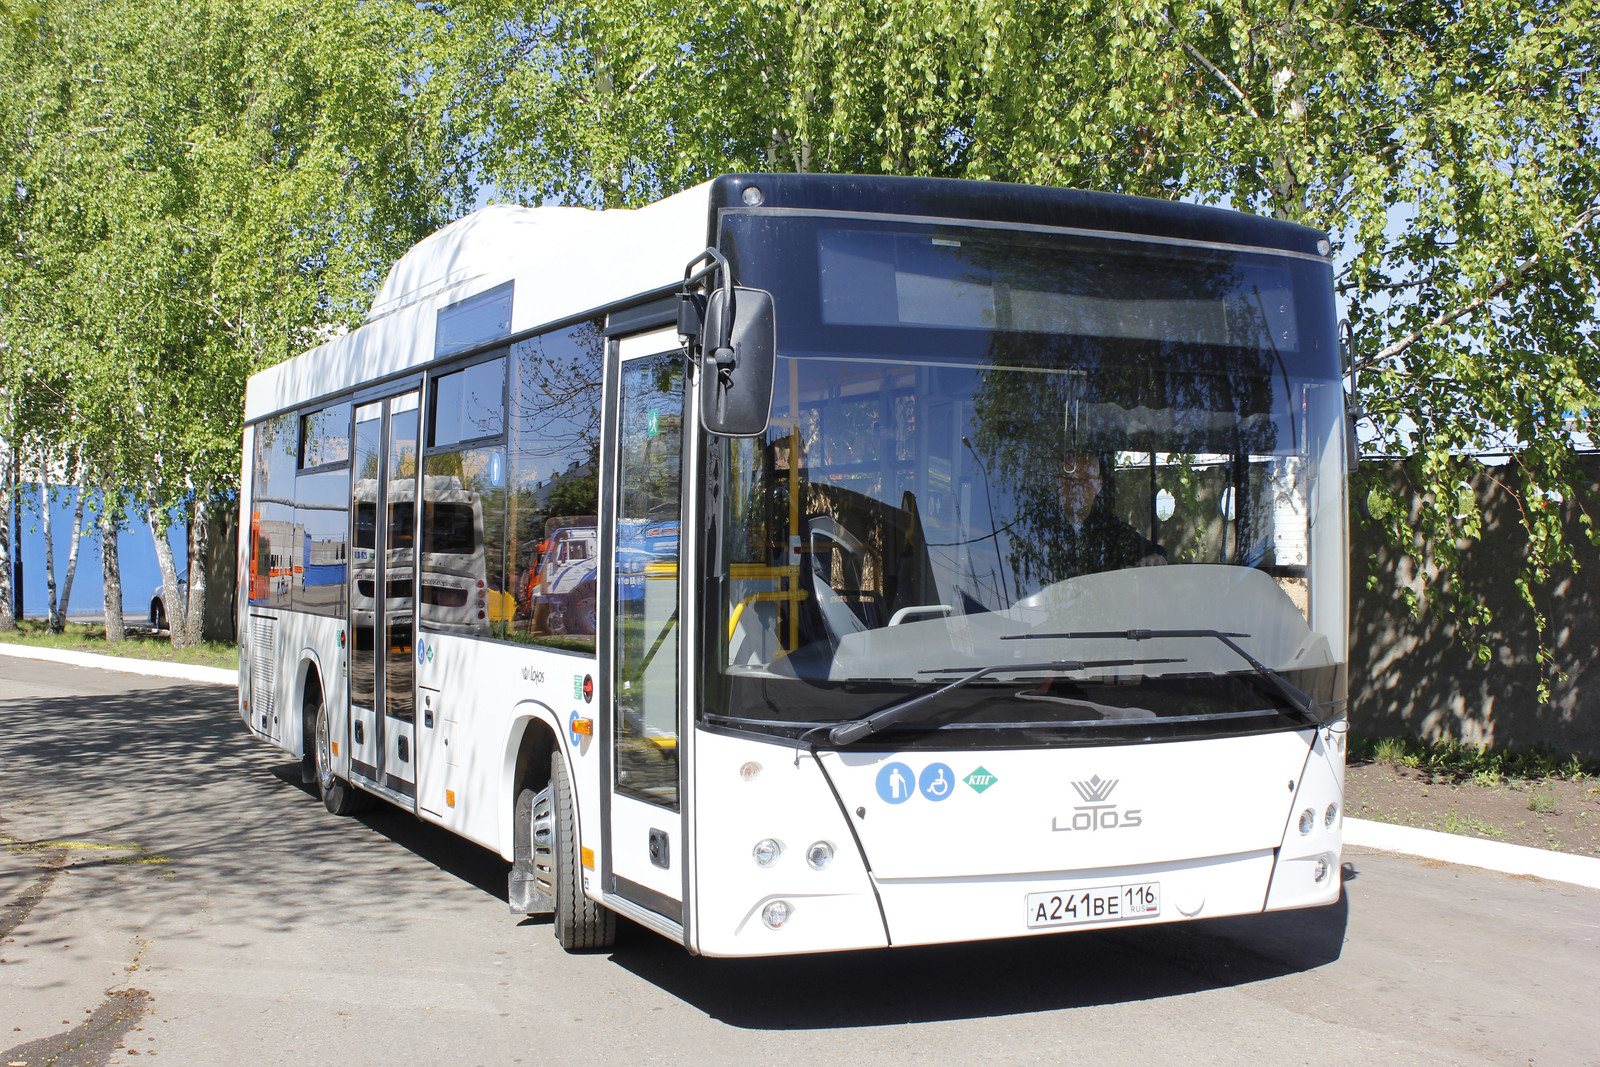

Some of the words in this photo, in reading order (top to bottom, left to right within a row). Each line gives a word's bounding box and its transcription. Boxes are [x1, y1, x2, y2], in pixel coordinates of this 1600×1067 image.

[968, 774, 993, 786] КПГ
[1052, 804, 1142, 832] LOTOS
[1125, 886, 1155, 905] 116
[1131, 904, 1146, 912] RUS
